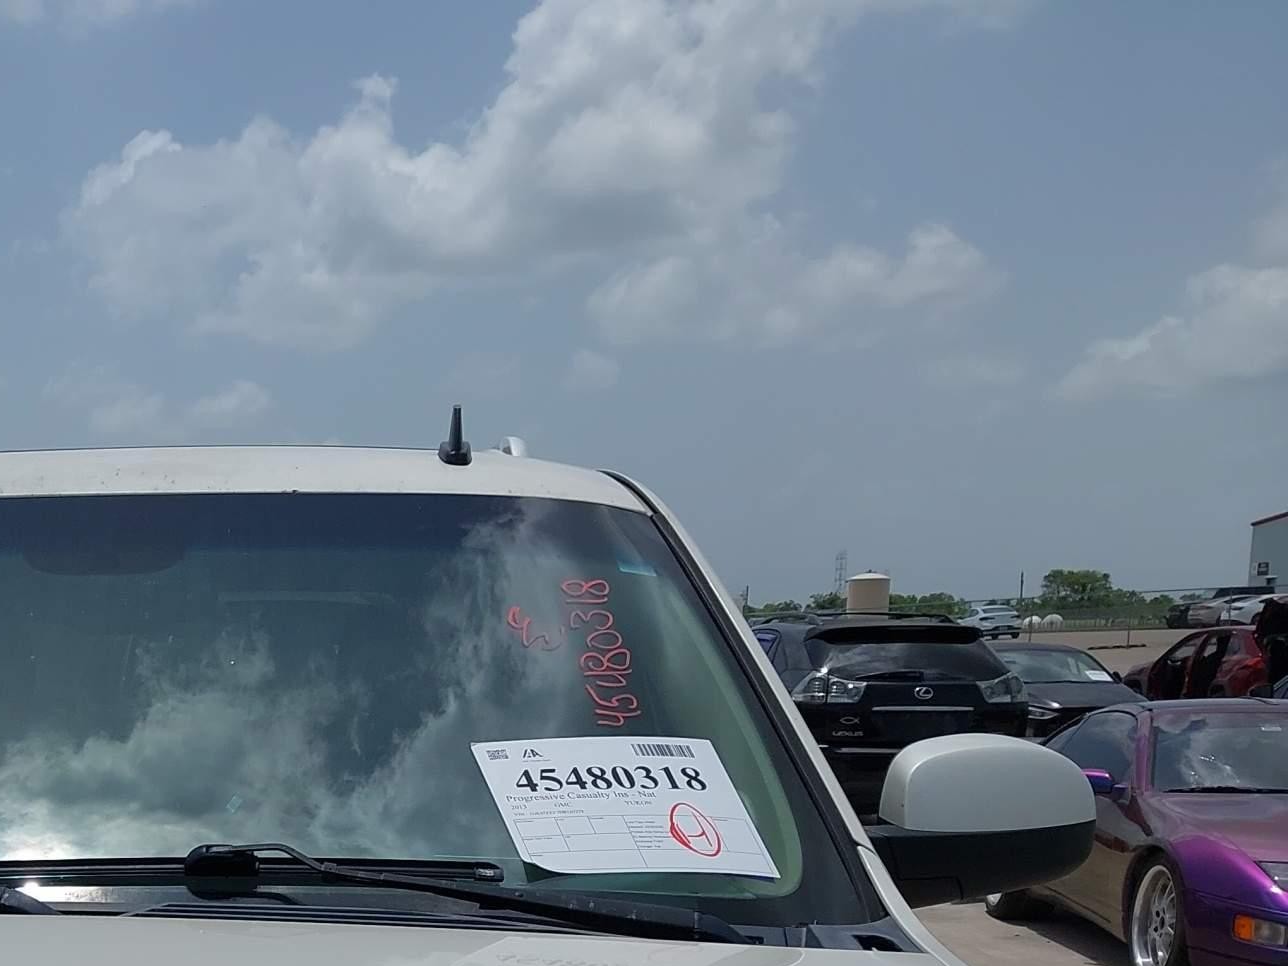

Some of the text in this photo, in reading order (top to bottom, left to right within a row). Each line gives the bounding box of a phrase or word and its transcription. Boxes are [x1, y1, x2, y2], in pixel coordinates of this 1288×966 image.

[561, 580, 642, 726] 45480318
[516, 766, 707, 792] 45480318
[506, 793, 565, 802] Progressive
[568, 791, 610, 800] Casualty
[638, 790, 657, 798] Nat
